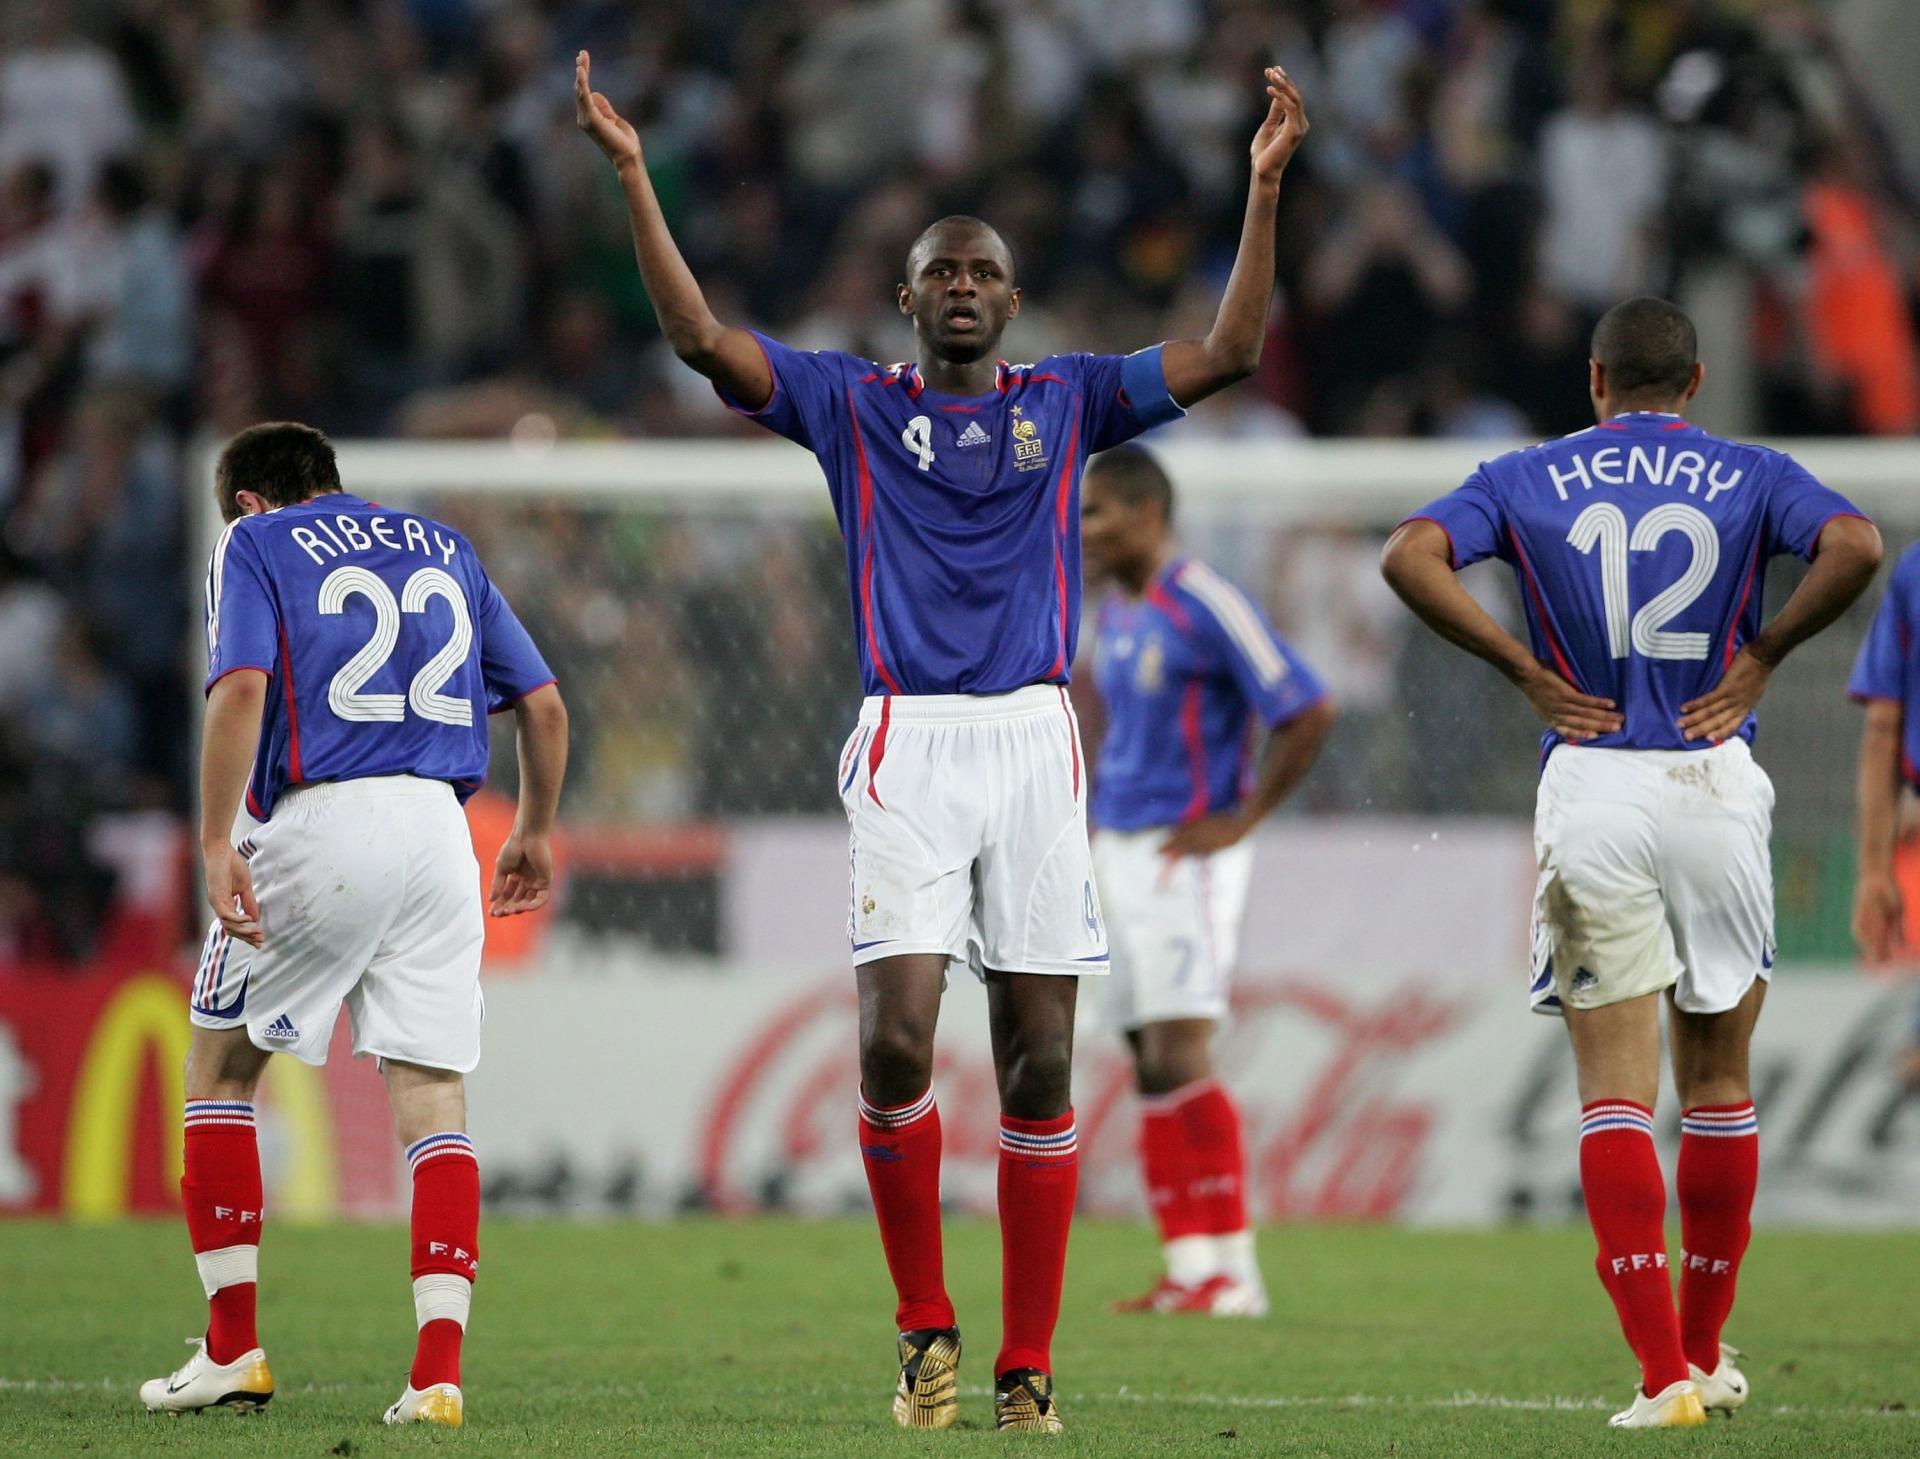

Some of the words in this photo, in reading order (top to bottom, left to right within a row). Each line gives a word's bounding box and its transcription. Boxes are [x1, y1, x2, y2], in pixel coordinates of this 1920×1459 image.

[956, 434, 992, 448] adidas
[1547, 445, 1743, 502] HENRY
[291, 515, 456, 565] RIBERY
[1565, 501, 1720, 661] 12
[318, 565, 473, 727] 22
[1084, 879, 1100, 943] 4
[264, 1028, 300, 1038] adidas
